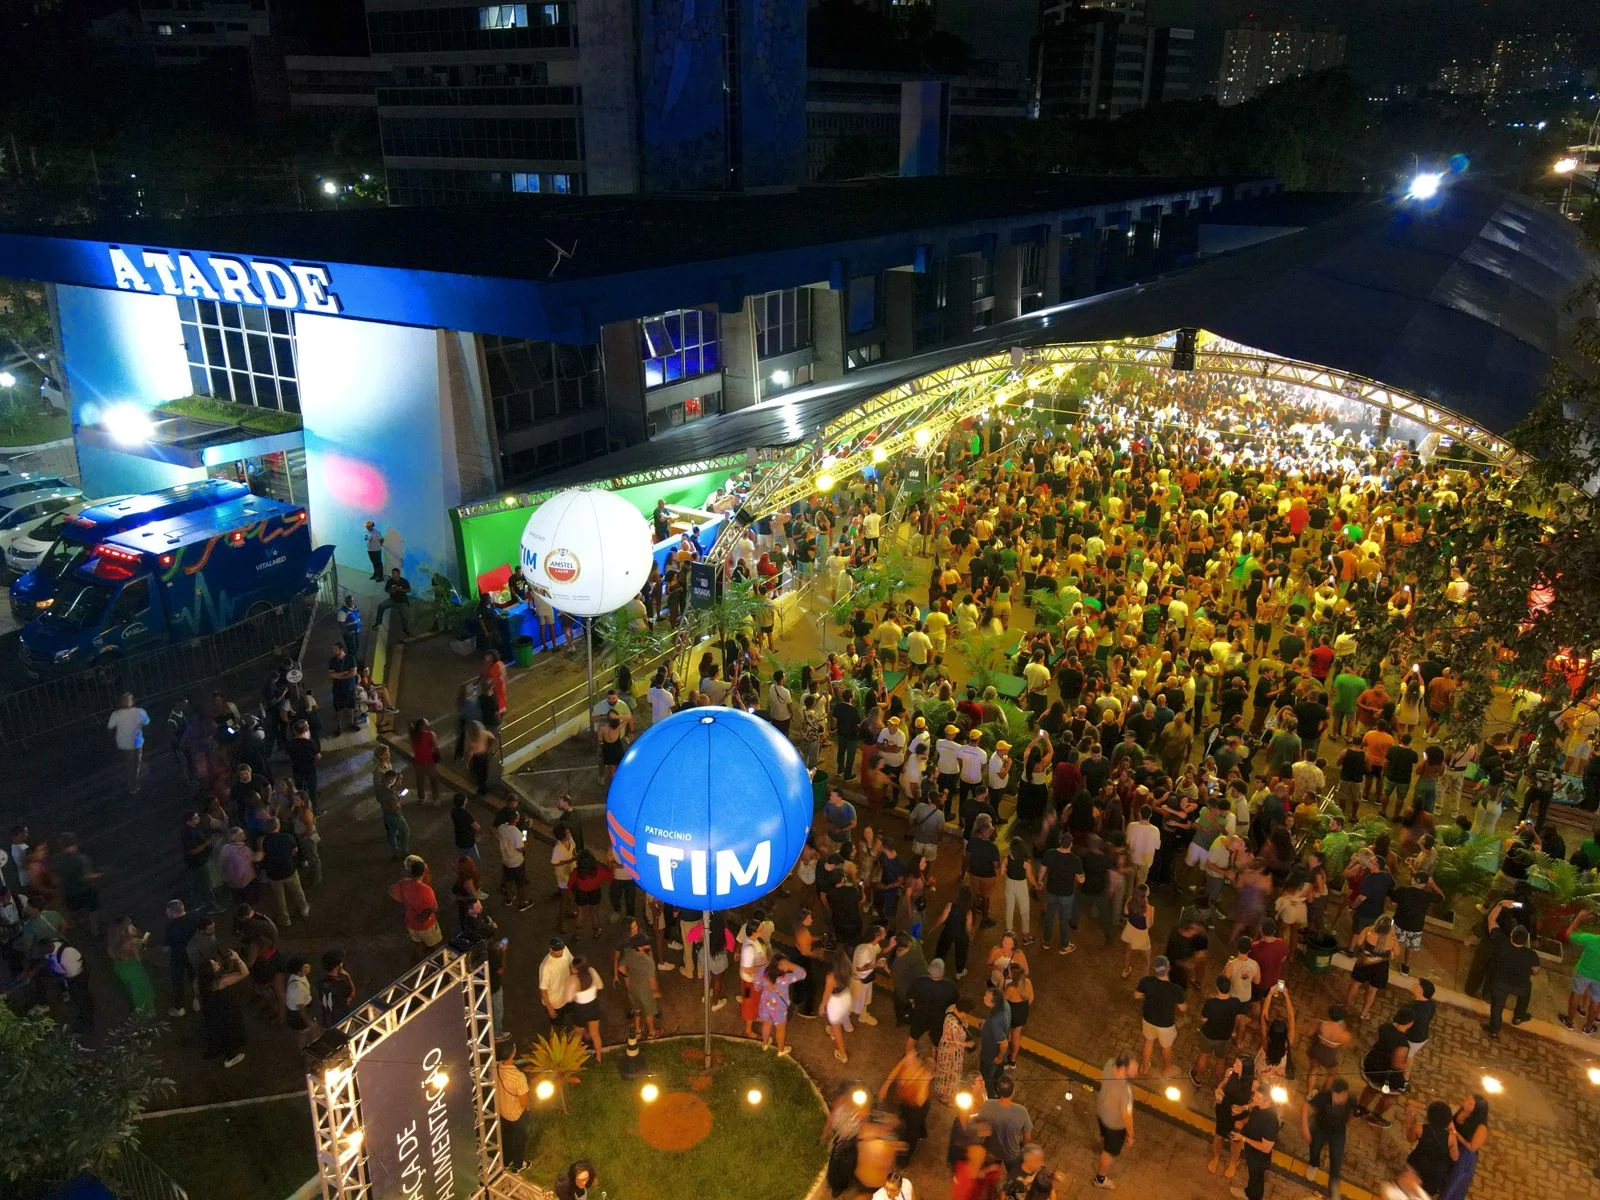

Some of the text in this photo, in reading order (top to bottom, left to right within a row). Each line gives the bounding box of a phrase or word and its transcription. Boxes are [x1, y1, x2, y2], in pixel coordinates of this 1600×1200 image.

[109, 248, 340, 314] A TARDE
[256, 556, 286, 570] VITALMED
[550, 560, 574, 569] AMSTEL
[645, 825, 692, 841] PATROCÍNIO
[646, 839, 772, 896] TIM
[396, 1119, 418, 1162] DE
[422, 1047, 456, 1200] ALIMENTAÇÃO
